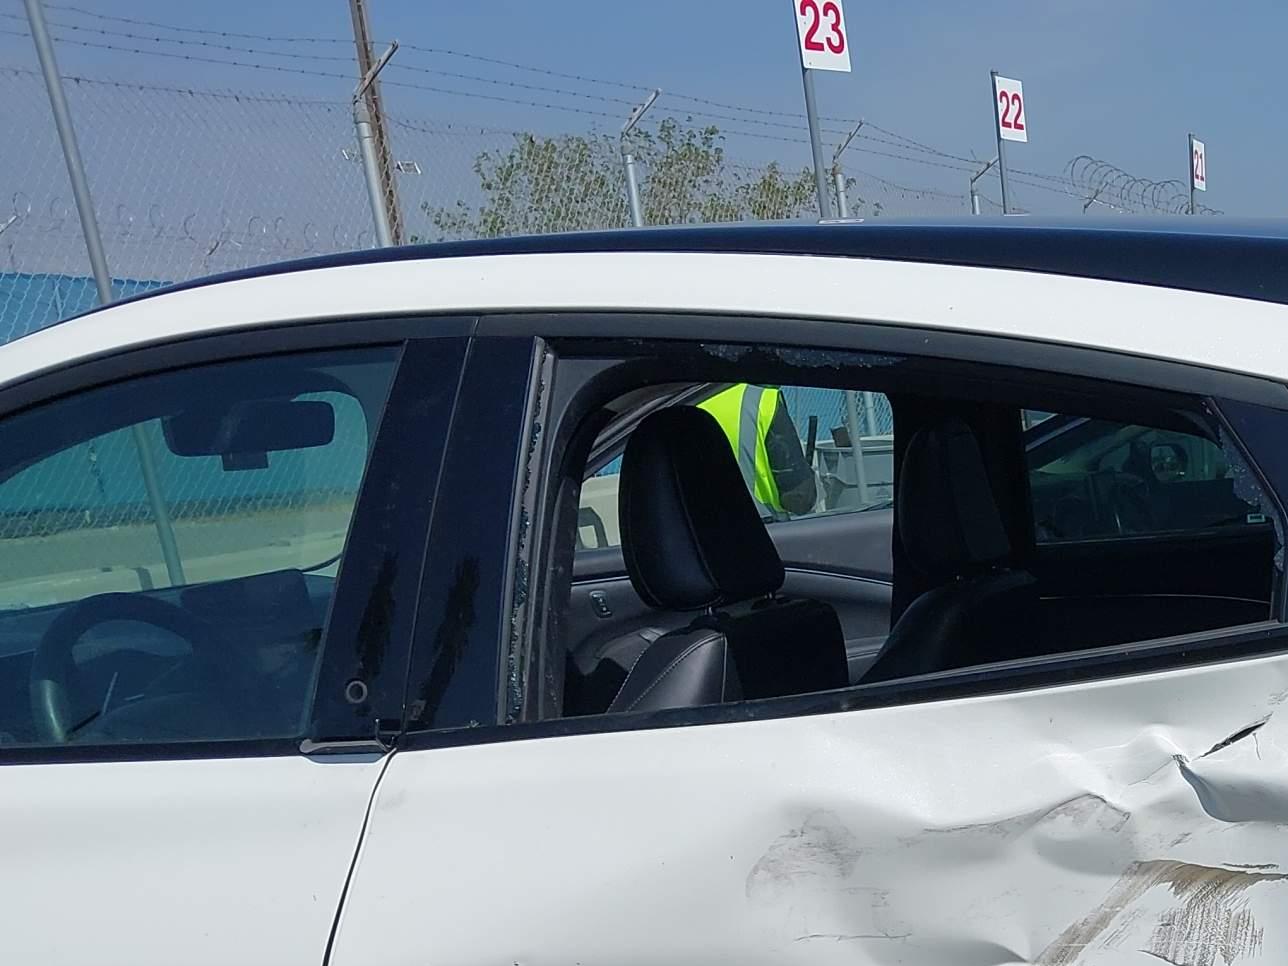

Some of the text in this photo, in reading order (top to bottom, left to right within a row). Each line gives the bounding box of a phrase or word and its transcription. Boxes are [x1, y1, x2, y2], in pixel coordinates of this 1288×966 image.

[800, 0, 845, 54] 23
[999, 91, 1025, 131] 22
[1194, 149, 1205, 182] 21
